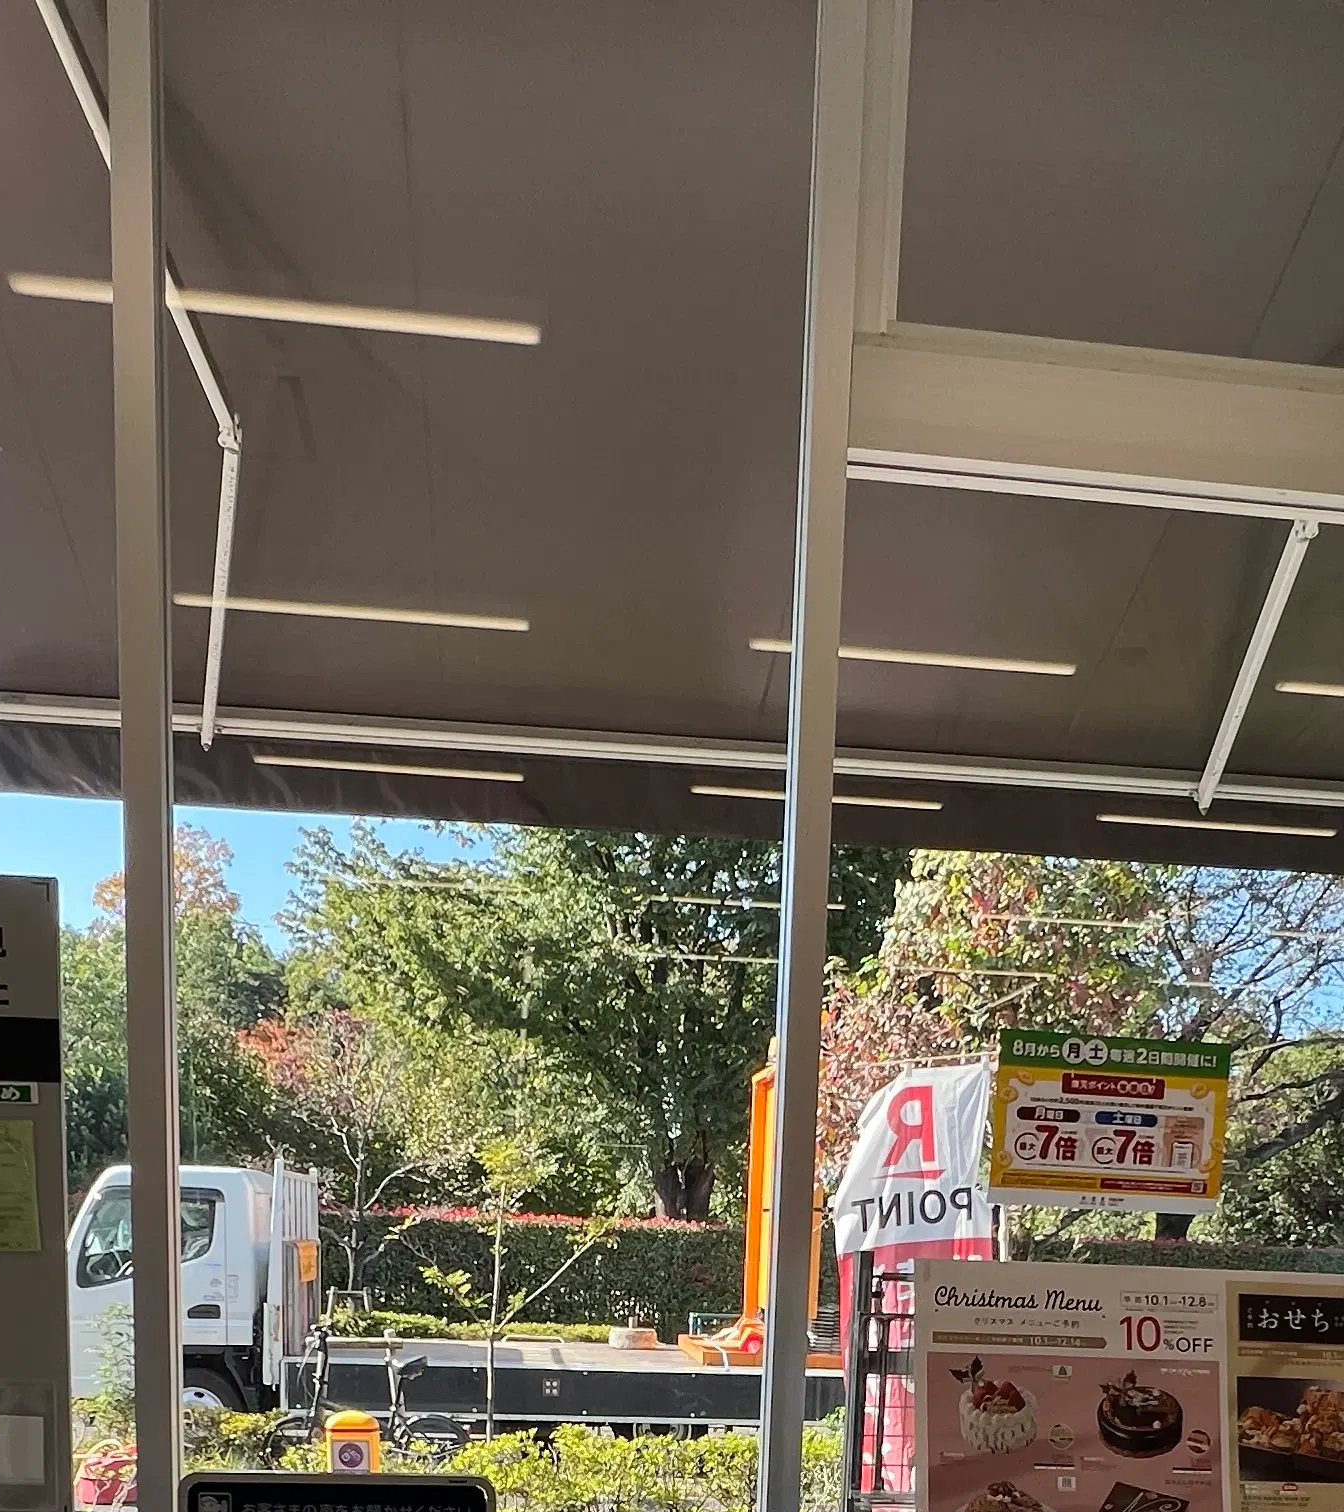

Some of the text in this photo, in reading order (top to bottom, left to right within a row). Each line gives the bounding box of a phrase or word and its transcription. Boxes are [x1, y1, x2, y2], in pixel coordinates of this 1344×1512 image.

[934, 1285, 1103, 1312] Christmas Menu
[1257, 1307, 1330, 1333] おせち
